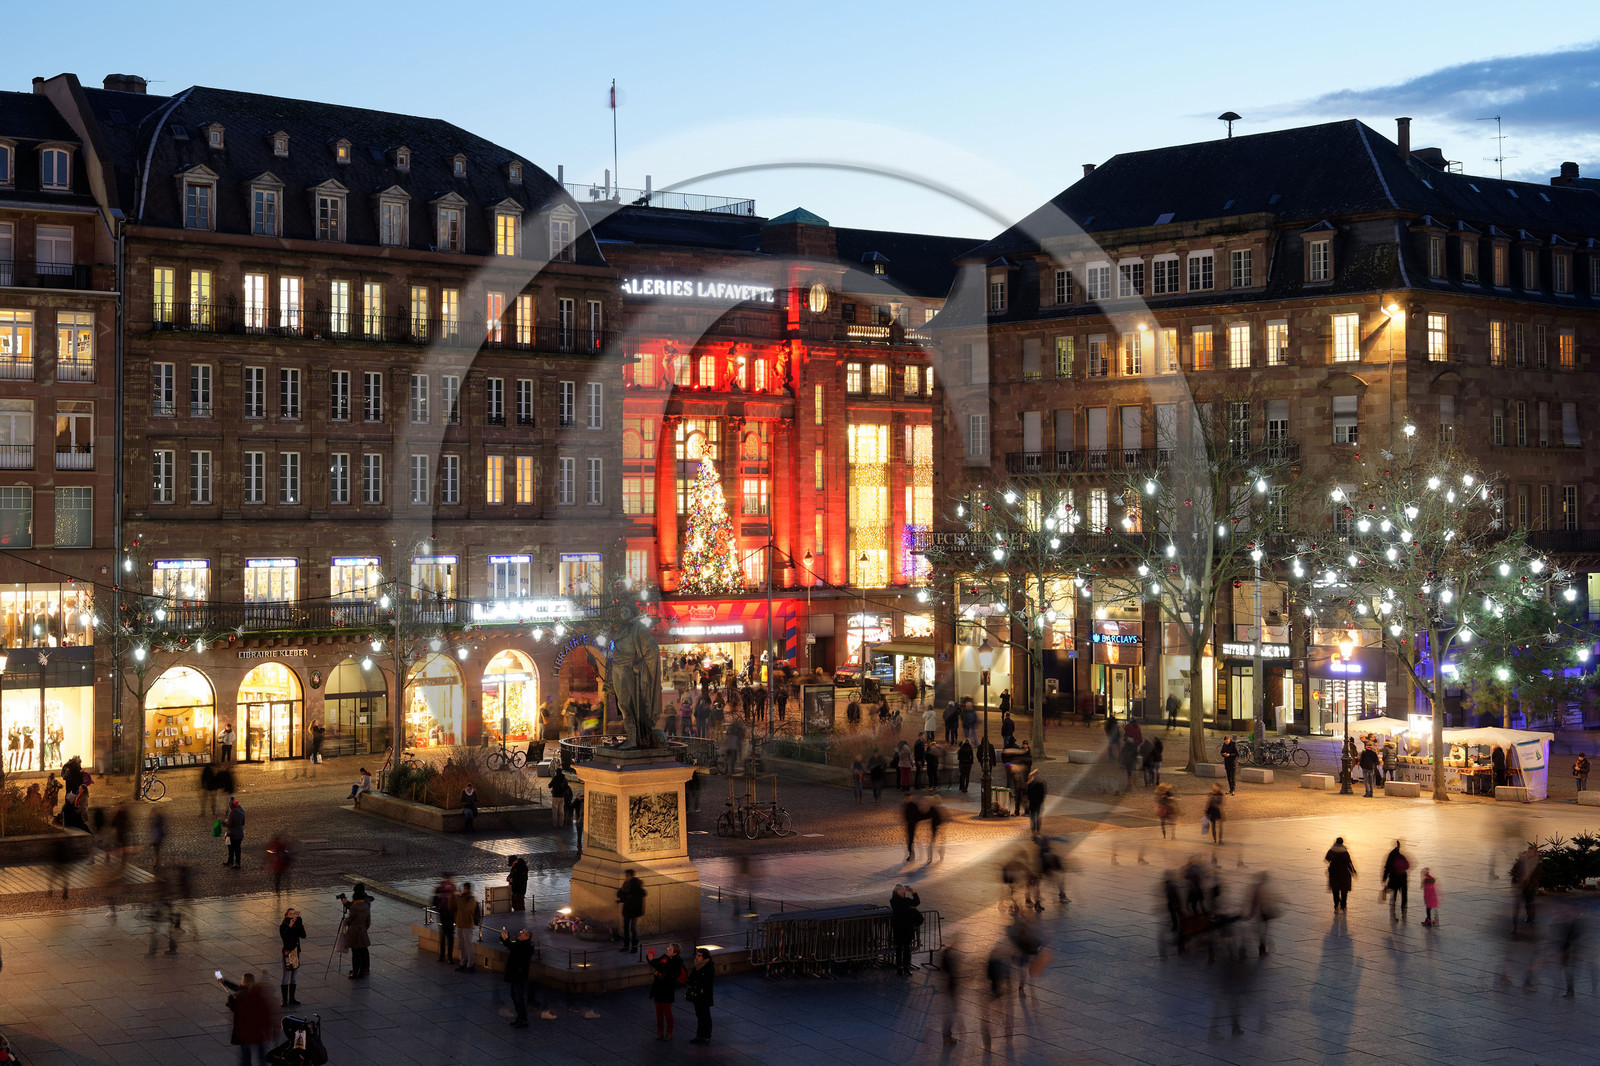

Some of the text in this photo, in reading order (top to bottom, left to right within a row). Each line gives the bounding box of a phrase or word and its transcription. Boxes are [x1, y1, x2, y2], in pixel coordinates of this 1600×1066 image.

[621, 278, 775, 303] ALERIES LAFAYETTE
[1101, 635, 1138, 644] BARCLAYS
[238, 650, 277, 659] LIBRAIRIE
